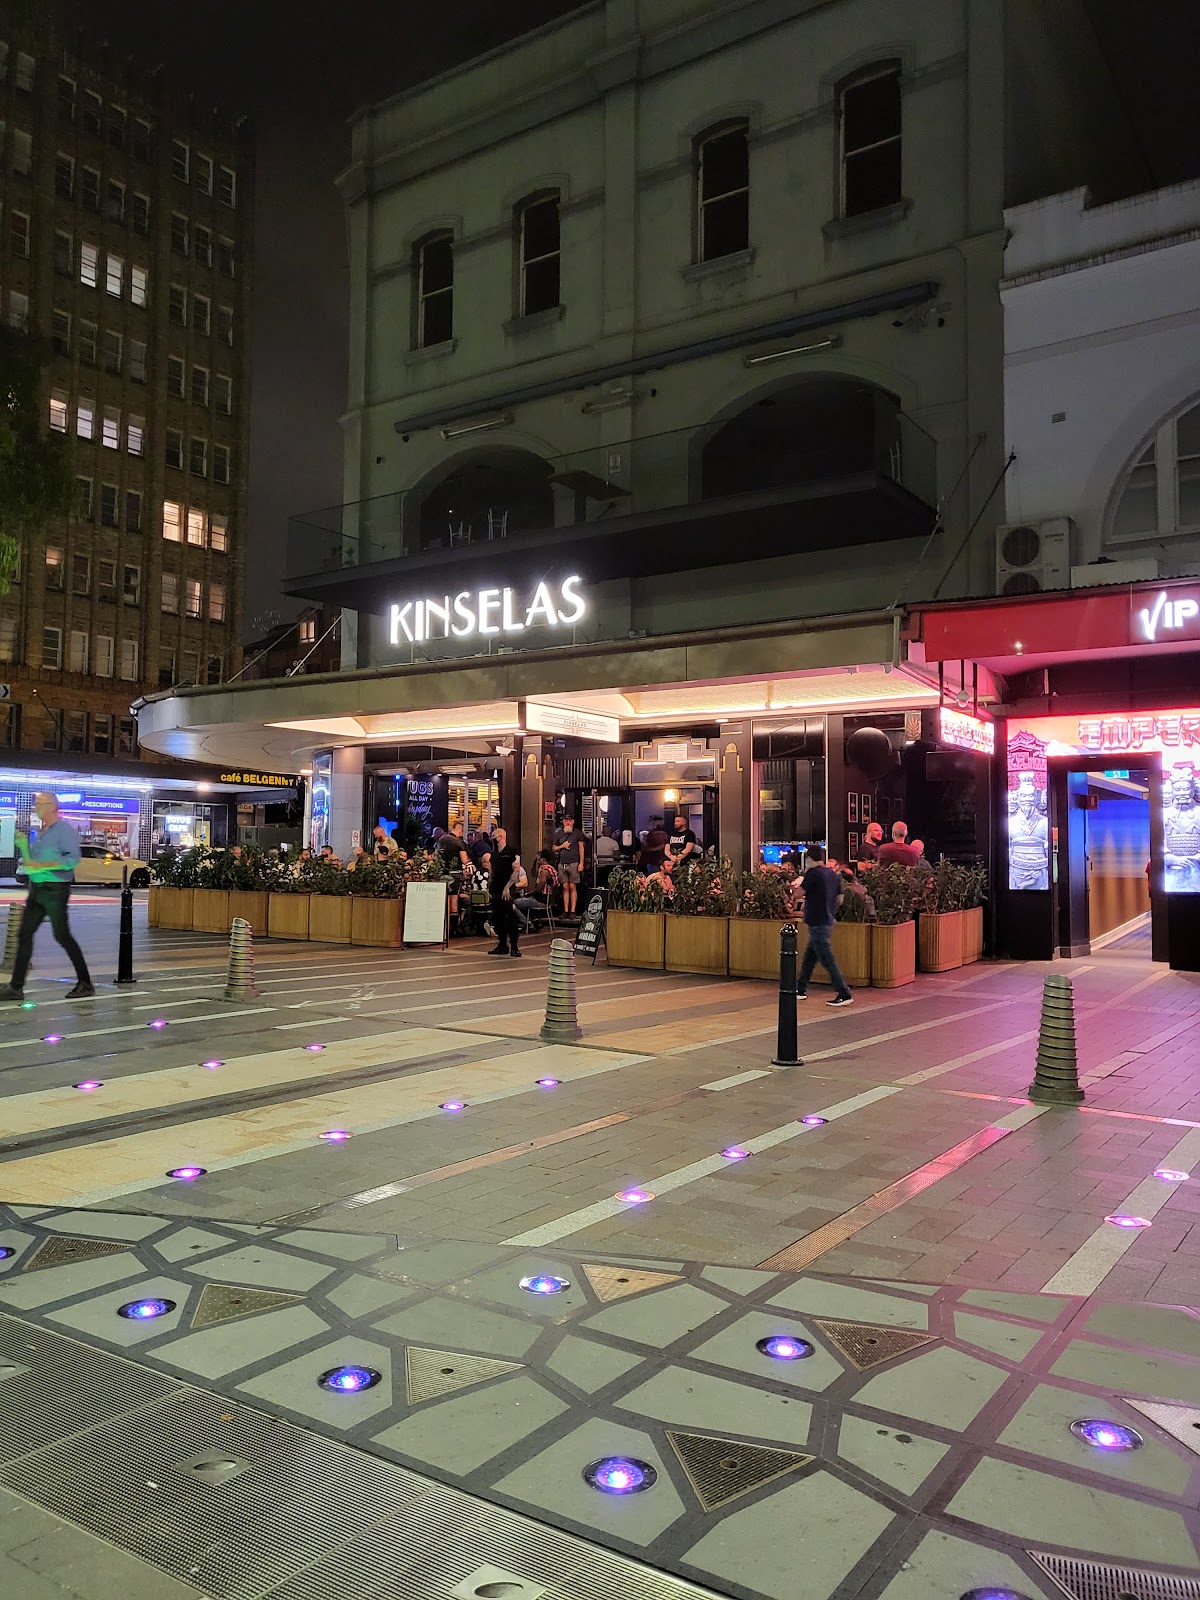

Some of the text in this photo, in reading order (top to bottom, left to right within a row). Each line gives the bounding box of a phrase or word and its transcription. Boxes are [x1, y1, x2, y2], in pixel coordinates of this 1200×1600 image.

[390, 575, 586, 645] KINSELAS
[1140, 591, 1199, 640] VIP
[220, 772, 294, 786] café BELGENNY
